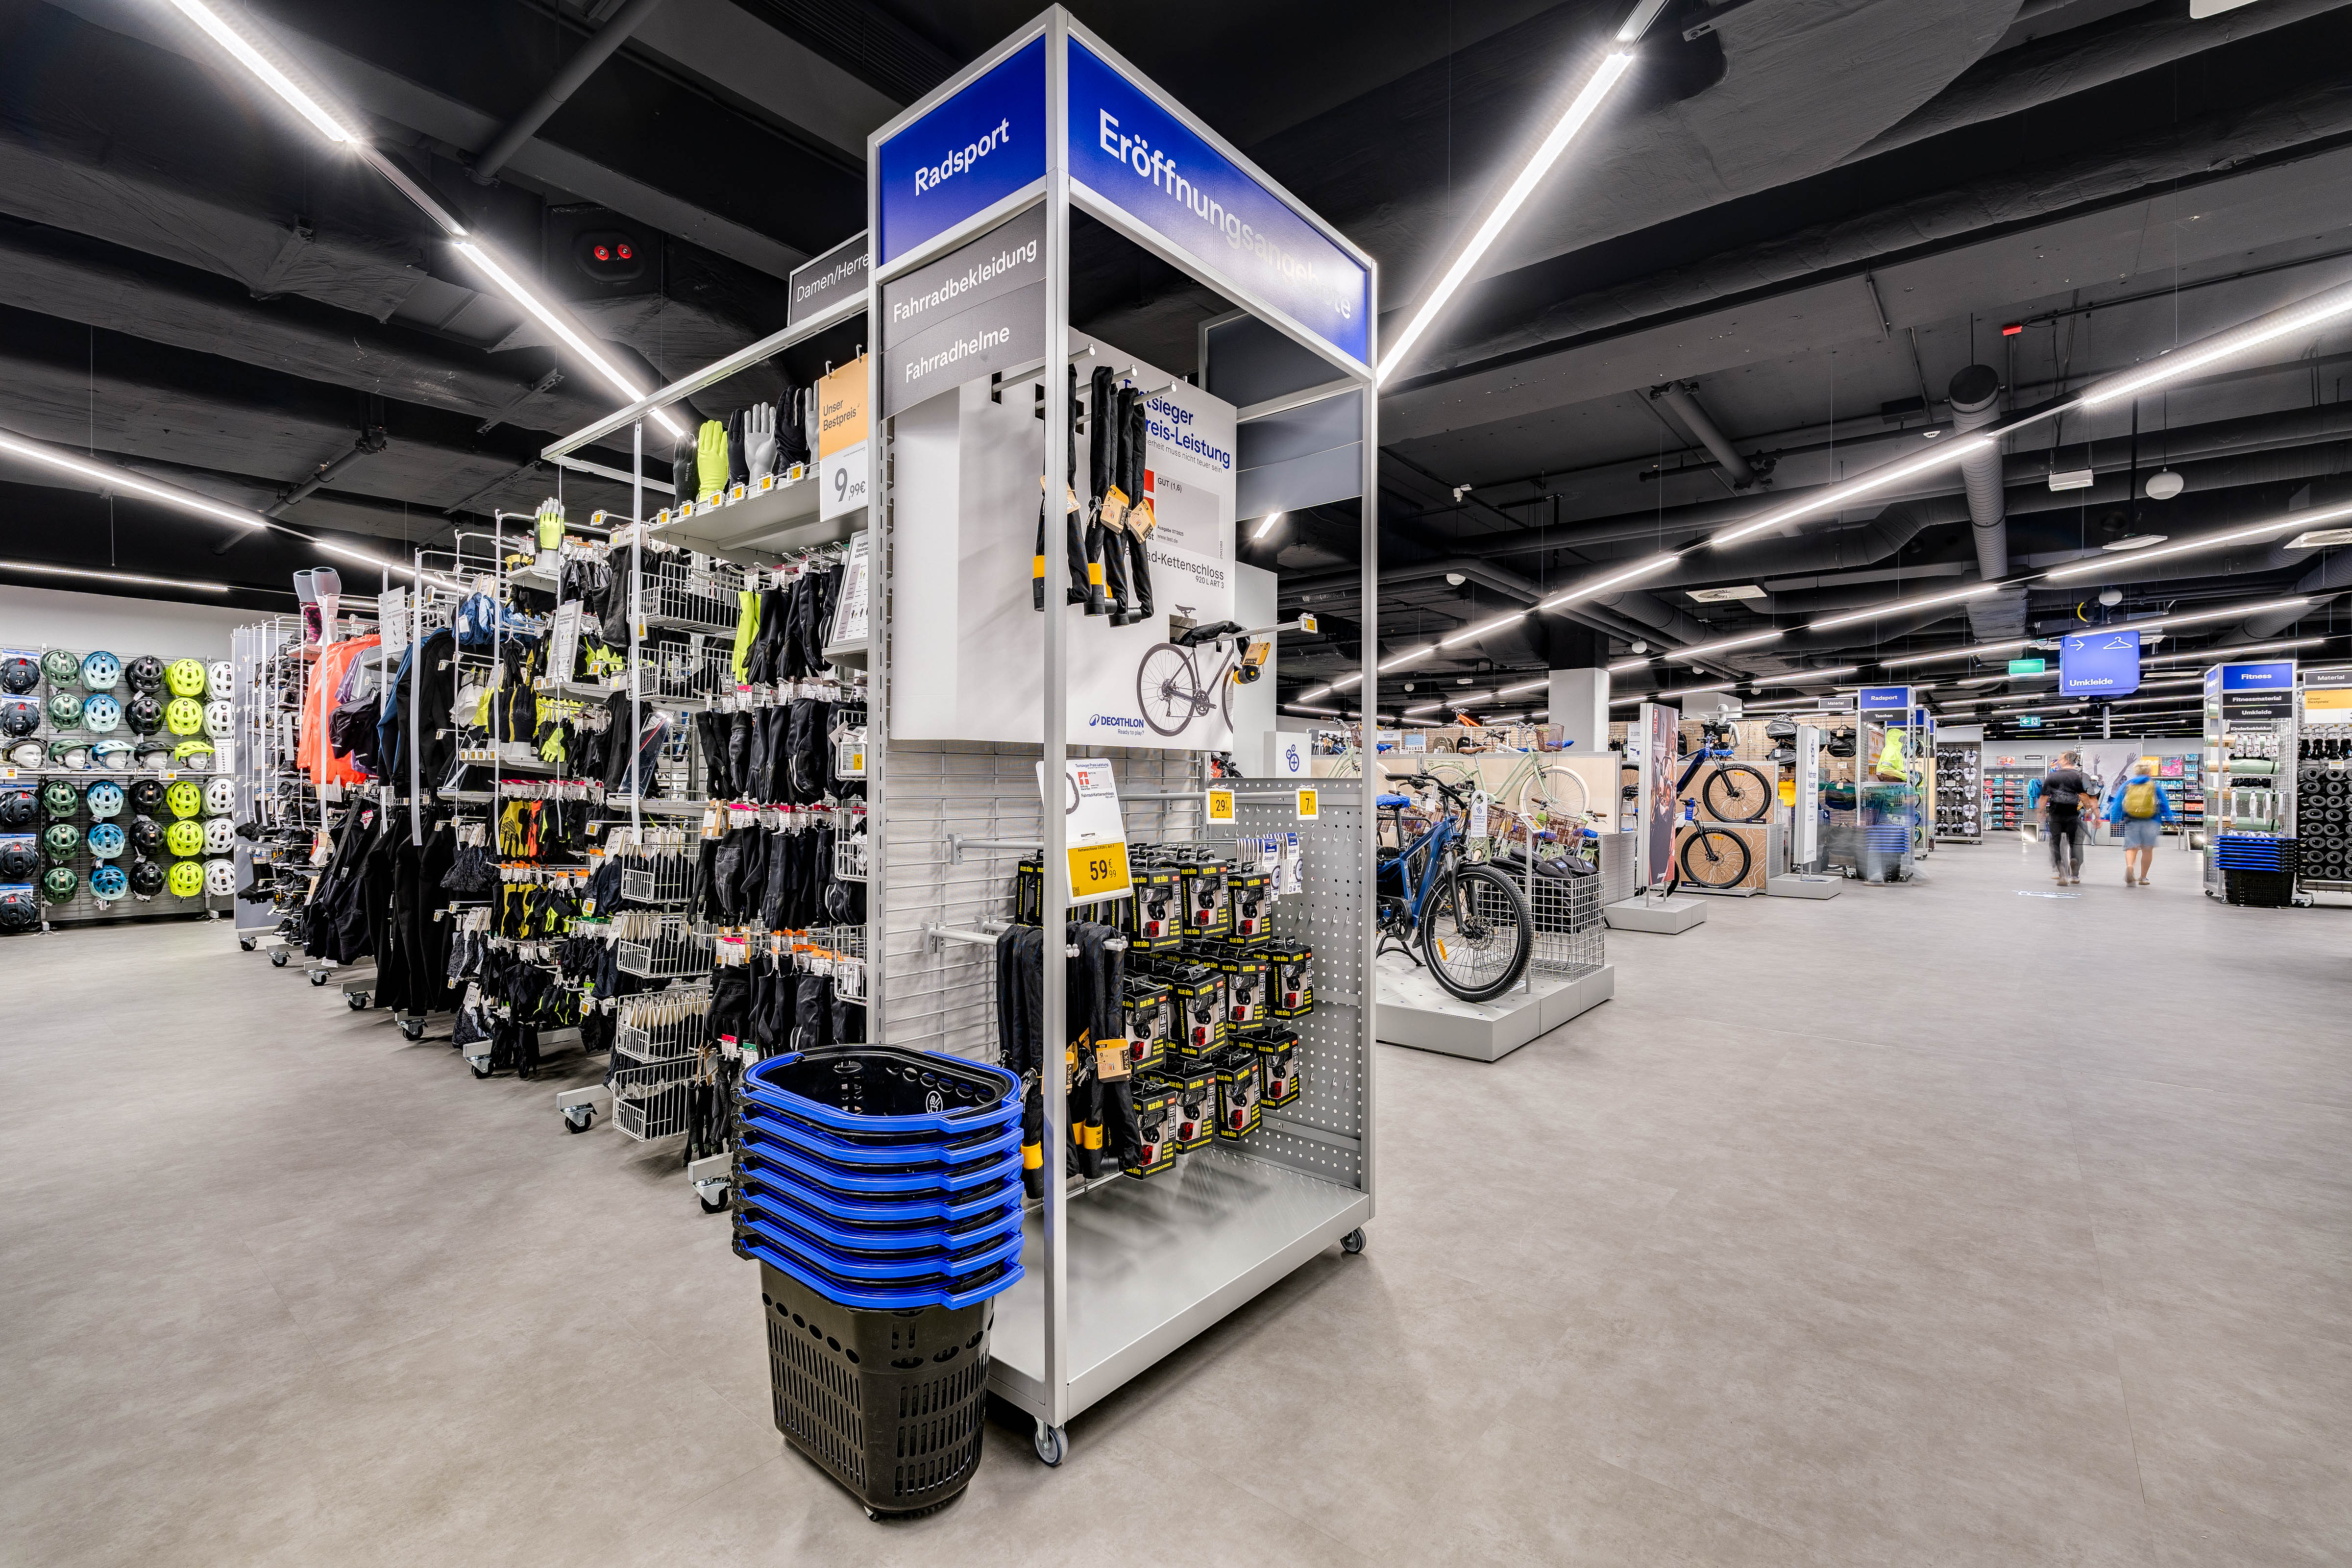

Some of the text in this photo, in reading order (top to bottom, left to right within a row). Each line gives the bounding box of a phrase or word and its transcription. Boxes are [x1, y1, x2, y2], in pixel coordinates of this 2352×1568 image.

[915, 118, 1009, 196] Radsport
[1100, 108, 1351, 319] Eröffnungsangebote
[797, 253, 868, 302] Damen/Herre
[893, 239, 1037, 323] Fahrradbekleidung
[906, 326, 1010, 383] Fahrradhelme
[823, 400, 843, 416] Unser
[823, 408, 856, 431] Bestpreis
[1146, 418, 1230, 469] reis-Leistung
[1166, 446, 1181, 457] muss
[1182, 453, 1196, 463] nicht
[1197, 457, 1210, 468] teuer
[1211, 465, 1222, 473] sein
[1157, 477, 1182, 493] GUT (1,6)
[1157, 525, 1172, 534] Ausgabe
[1157, 534, 1178, 544] www.test.de
[1196, 576, 1205, 584] 920
[2070, 678, 2113, 686] Umkleide
[1102, 716, 1144, 728] DECATHLON
[1216, 799, 1225, 811] 29
[1305, 798, 1310, 811] 7
[1090, 859, 1107, 881] 59
[1108, 858, 1112, 868] €
[1109, 870, 1116, 878] 99
